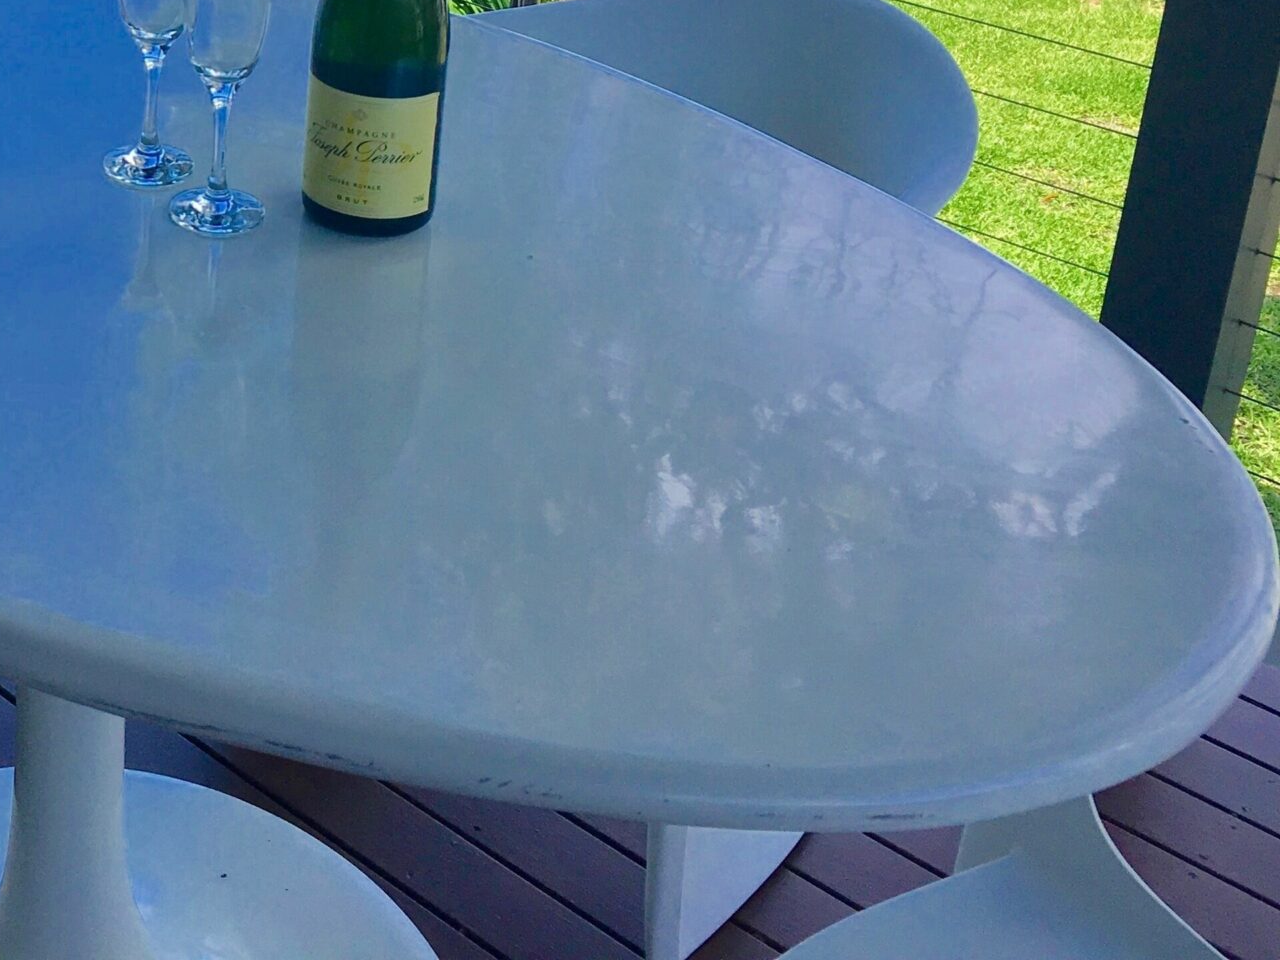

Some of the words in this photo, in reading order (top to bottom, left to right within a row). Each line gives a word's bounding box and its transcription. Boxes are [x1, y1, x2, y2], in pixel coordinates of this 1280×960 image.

[325, 120, 395, 139] CHAMPAGNE
[308, 121, 353, 158] Joseph
[356, 139, 422, 164] Perrier
[336, 193, 368, 205] BRUT
